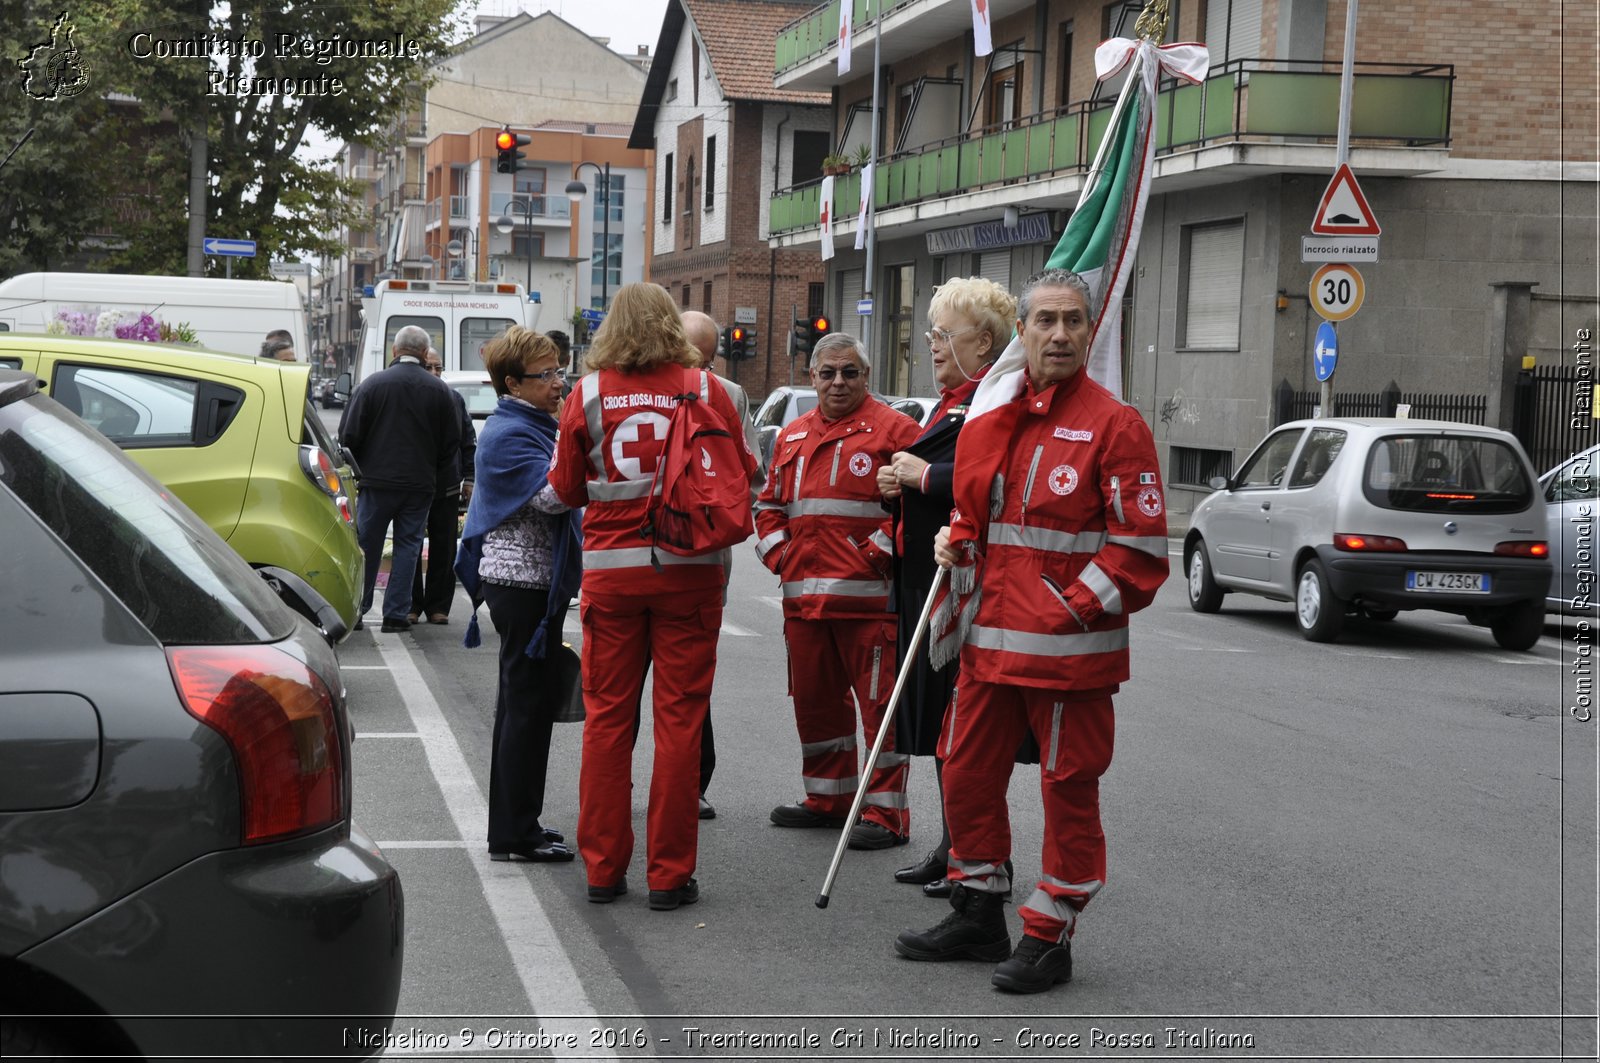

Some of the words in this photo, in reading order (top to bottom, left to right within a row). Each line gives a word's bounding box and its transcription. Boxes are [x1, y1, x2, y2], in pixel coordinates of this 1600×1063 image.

[927, 227, 971, 252] ZANNONI
[975, 214, 1051, 249] ASSICURAZIONI
[1304, 245, 1339, 254] incrocio
[1342, 245, 1376, 254] rialzato
[1323, 279, 1351, 305] 30
[403, 300, 423, 308] CROCE
[423, 300, 443, 309] ROSSA
[443, 301, 469, 309] ITALIANA
[469, 302, 499, 310] NICHELINO
[603, 395, 629, 410] CROCE
[629, 393, 653, 407] ROSSA
[654, 395, 679, 410] ITALIA
[1416, 573, 1434, 588] CW
[1439, 574, 1481, 590] 423GK
